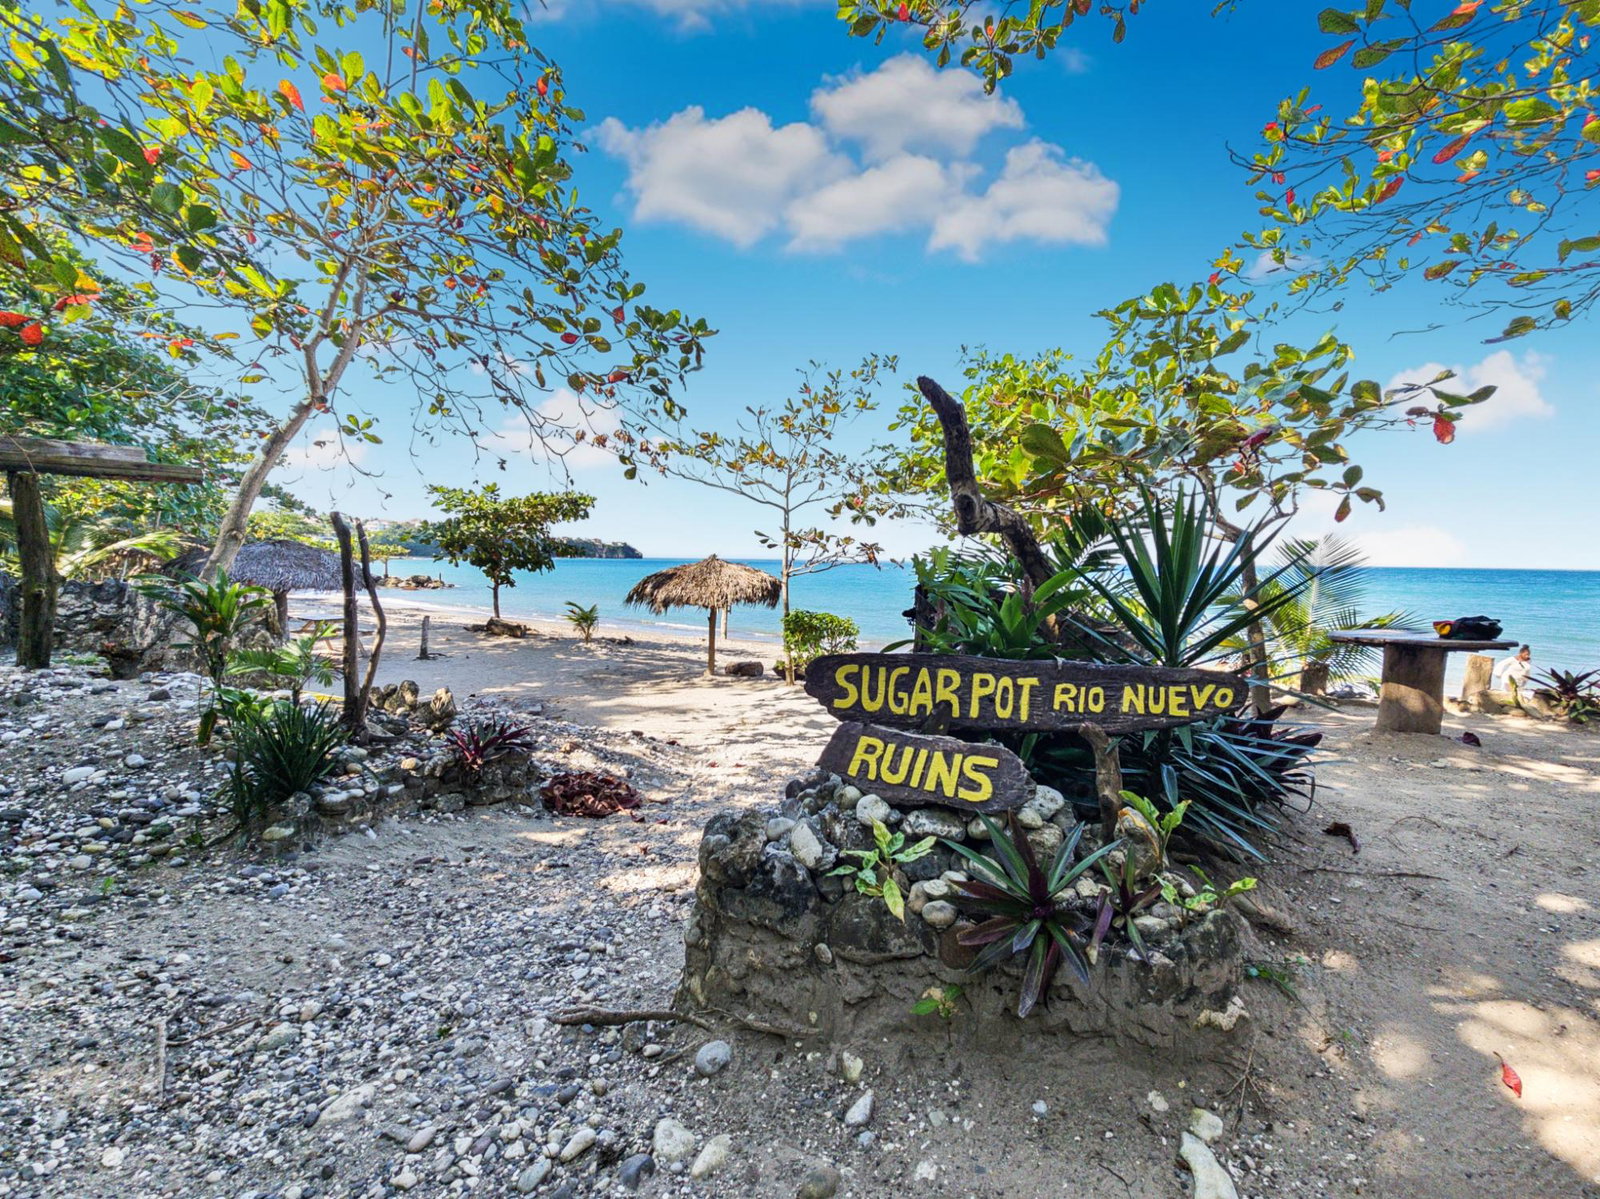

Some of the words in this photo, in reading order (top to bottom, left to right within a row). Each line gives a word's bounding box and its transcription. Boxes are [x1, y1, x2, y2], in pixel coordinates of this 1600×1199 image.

[833, 664, 961, 718] SUGAR
[969, 672, 1040, 722] POT
[1053, 682, 1106, 714] RIO
[1121, 683, 1234, 717] NUEVO
[847, 735, 999, 802] RUINS
